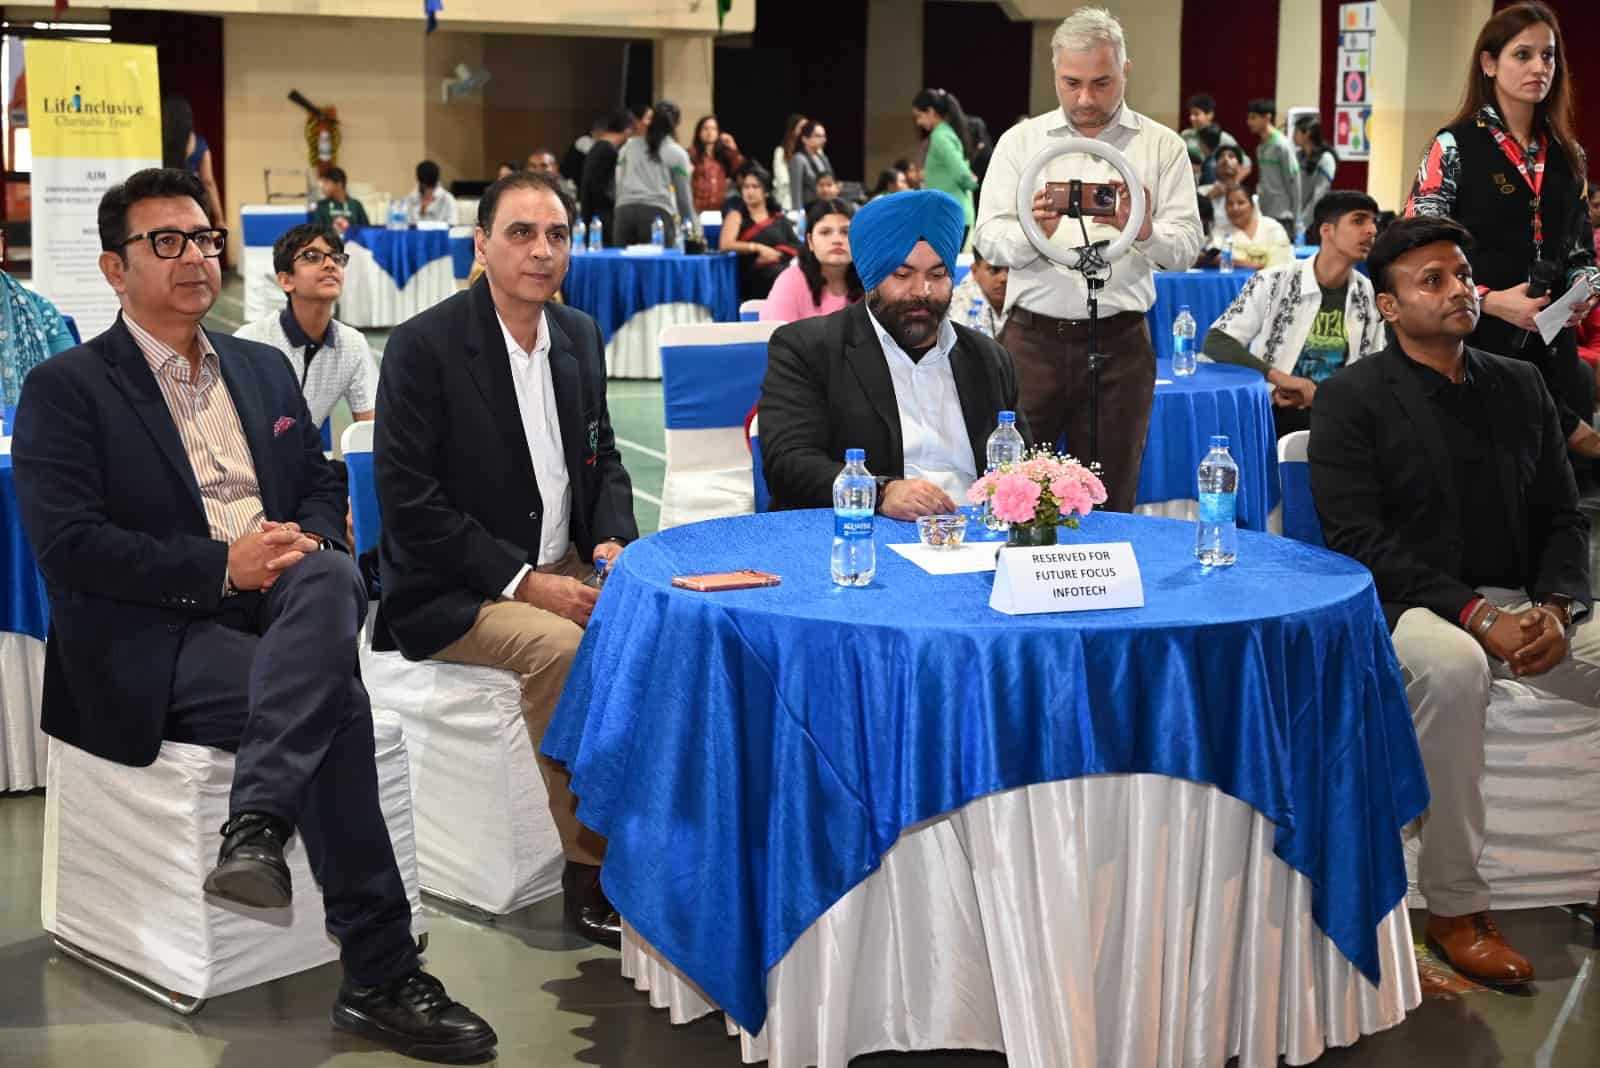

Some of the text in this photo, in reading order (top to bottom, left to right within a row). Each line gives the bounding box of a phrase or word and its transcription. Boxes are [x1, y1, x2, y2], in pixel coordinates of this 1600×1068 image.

[1032, 551, 1111, 564] RESERVED FOR
[1035, 567, 1116, 581] FUTURE FOCUS
[1052, 585, 1107, 598] INFOTECH
